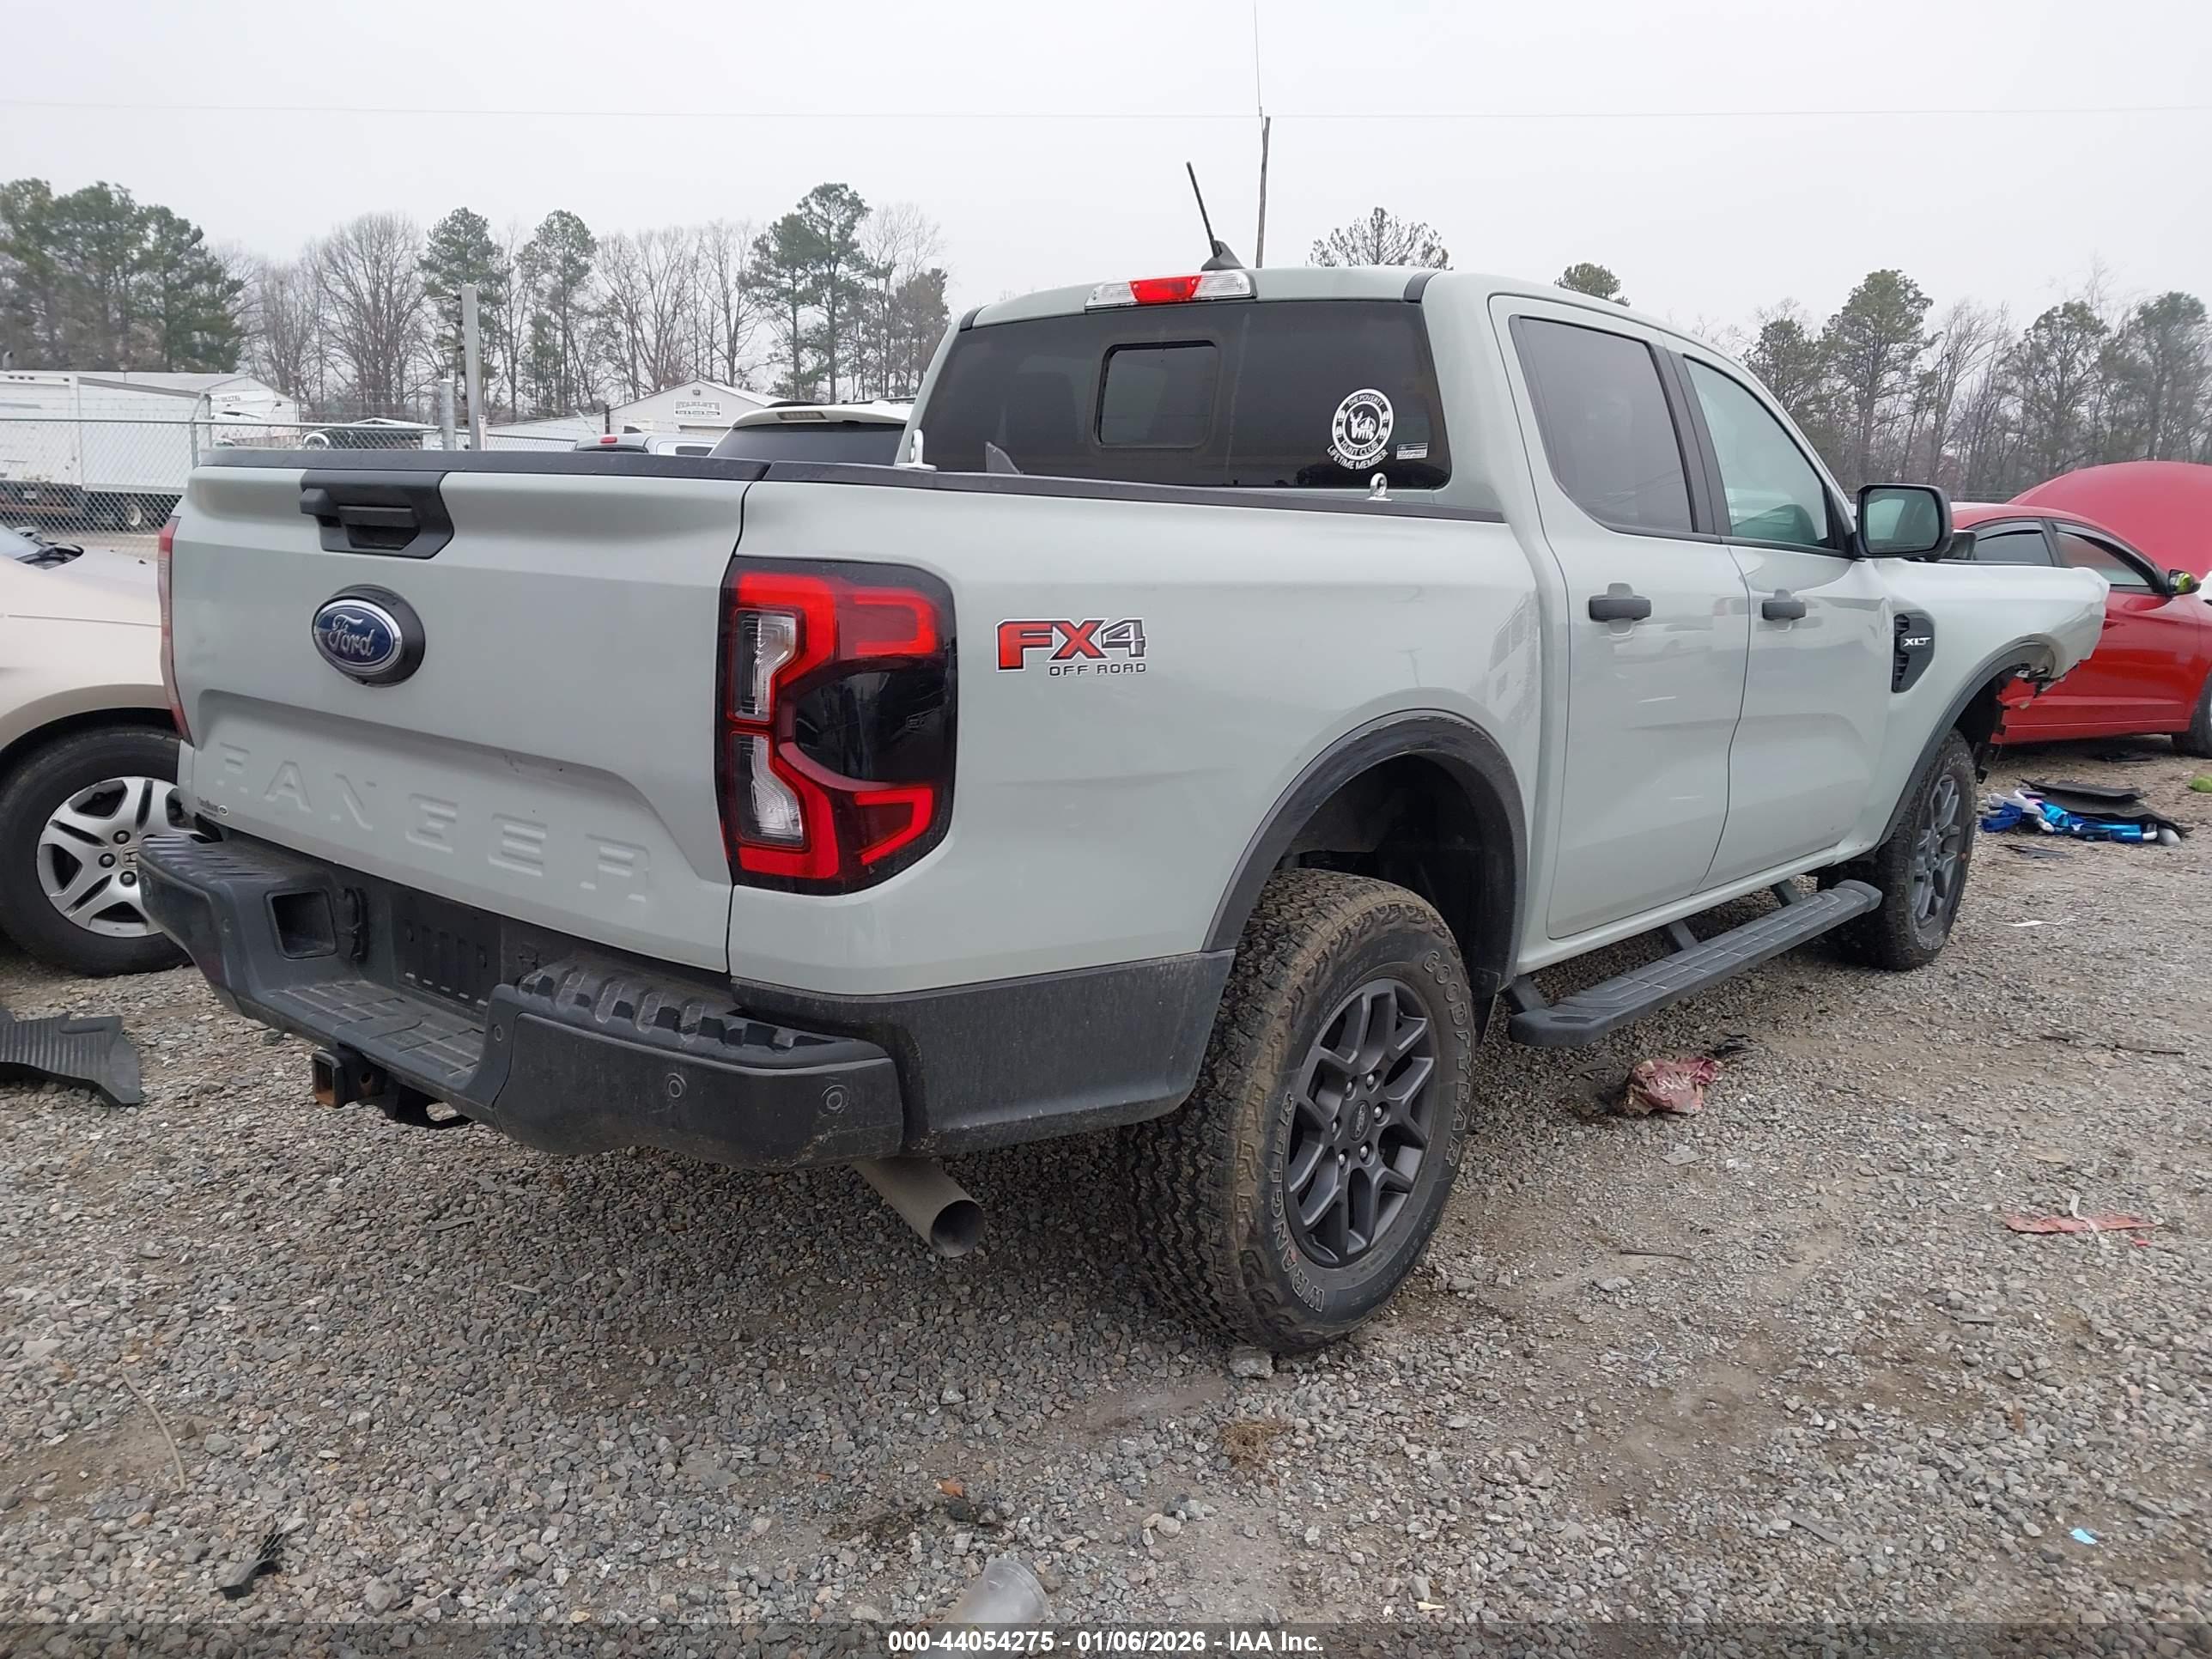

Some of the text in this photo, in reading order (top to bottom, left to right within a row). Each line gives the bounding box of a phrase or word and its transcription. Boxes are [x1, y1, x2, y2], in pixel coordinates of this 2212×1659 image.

[1326, 445, 1389, 471] LIFETIME MEMBER
[1340, 440, 1379, 456] HUNT CLUB
[328, 613, 375, 657] Ford
[994, 617, 1147, 672] FX4
[1903, 636, 1931, 647] XLT
[1048, 663, 1147, 677] OFF ROAD
[215, 741, 651, 902] RANGER
[1424, 951, 1472, 1166] GOODYEAR
[1271, 1091, 1324, 1312] WRANGLER
